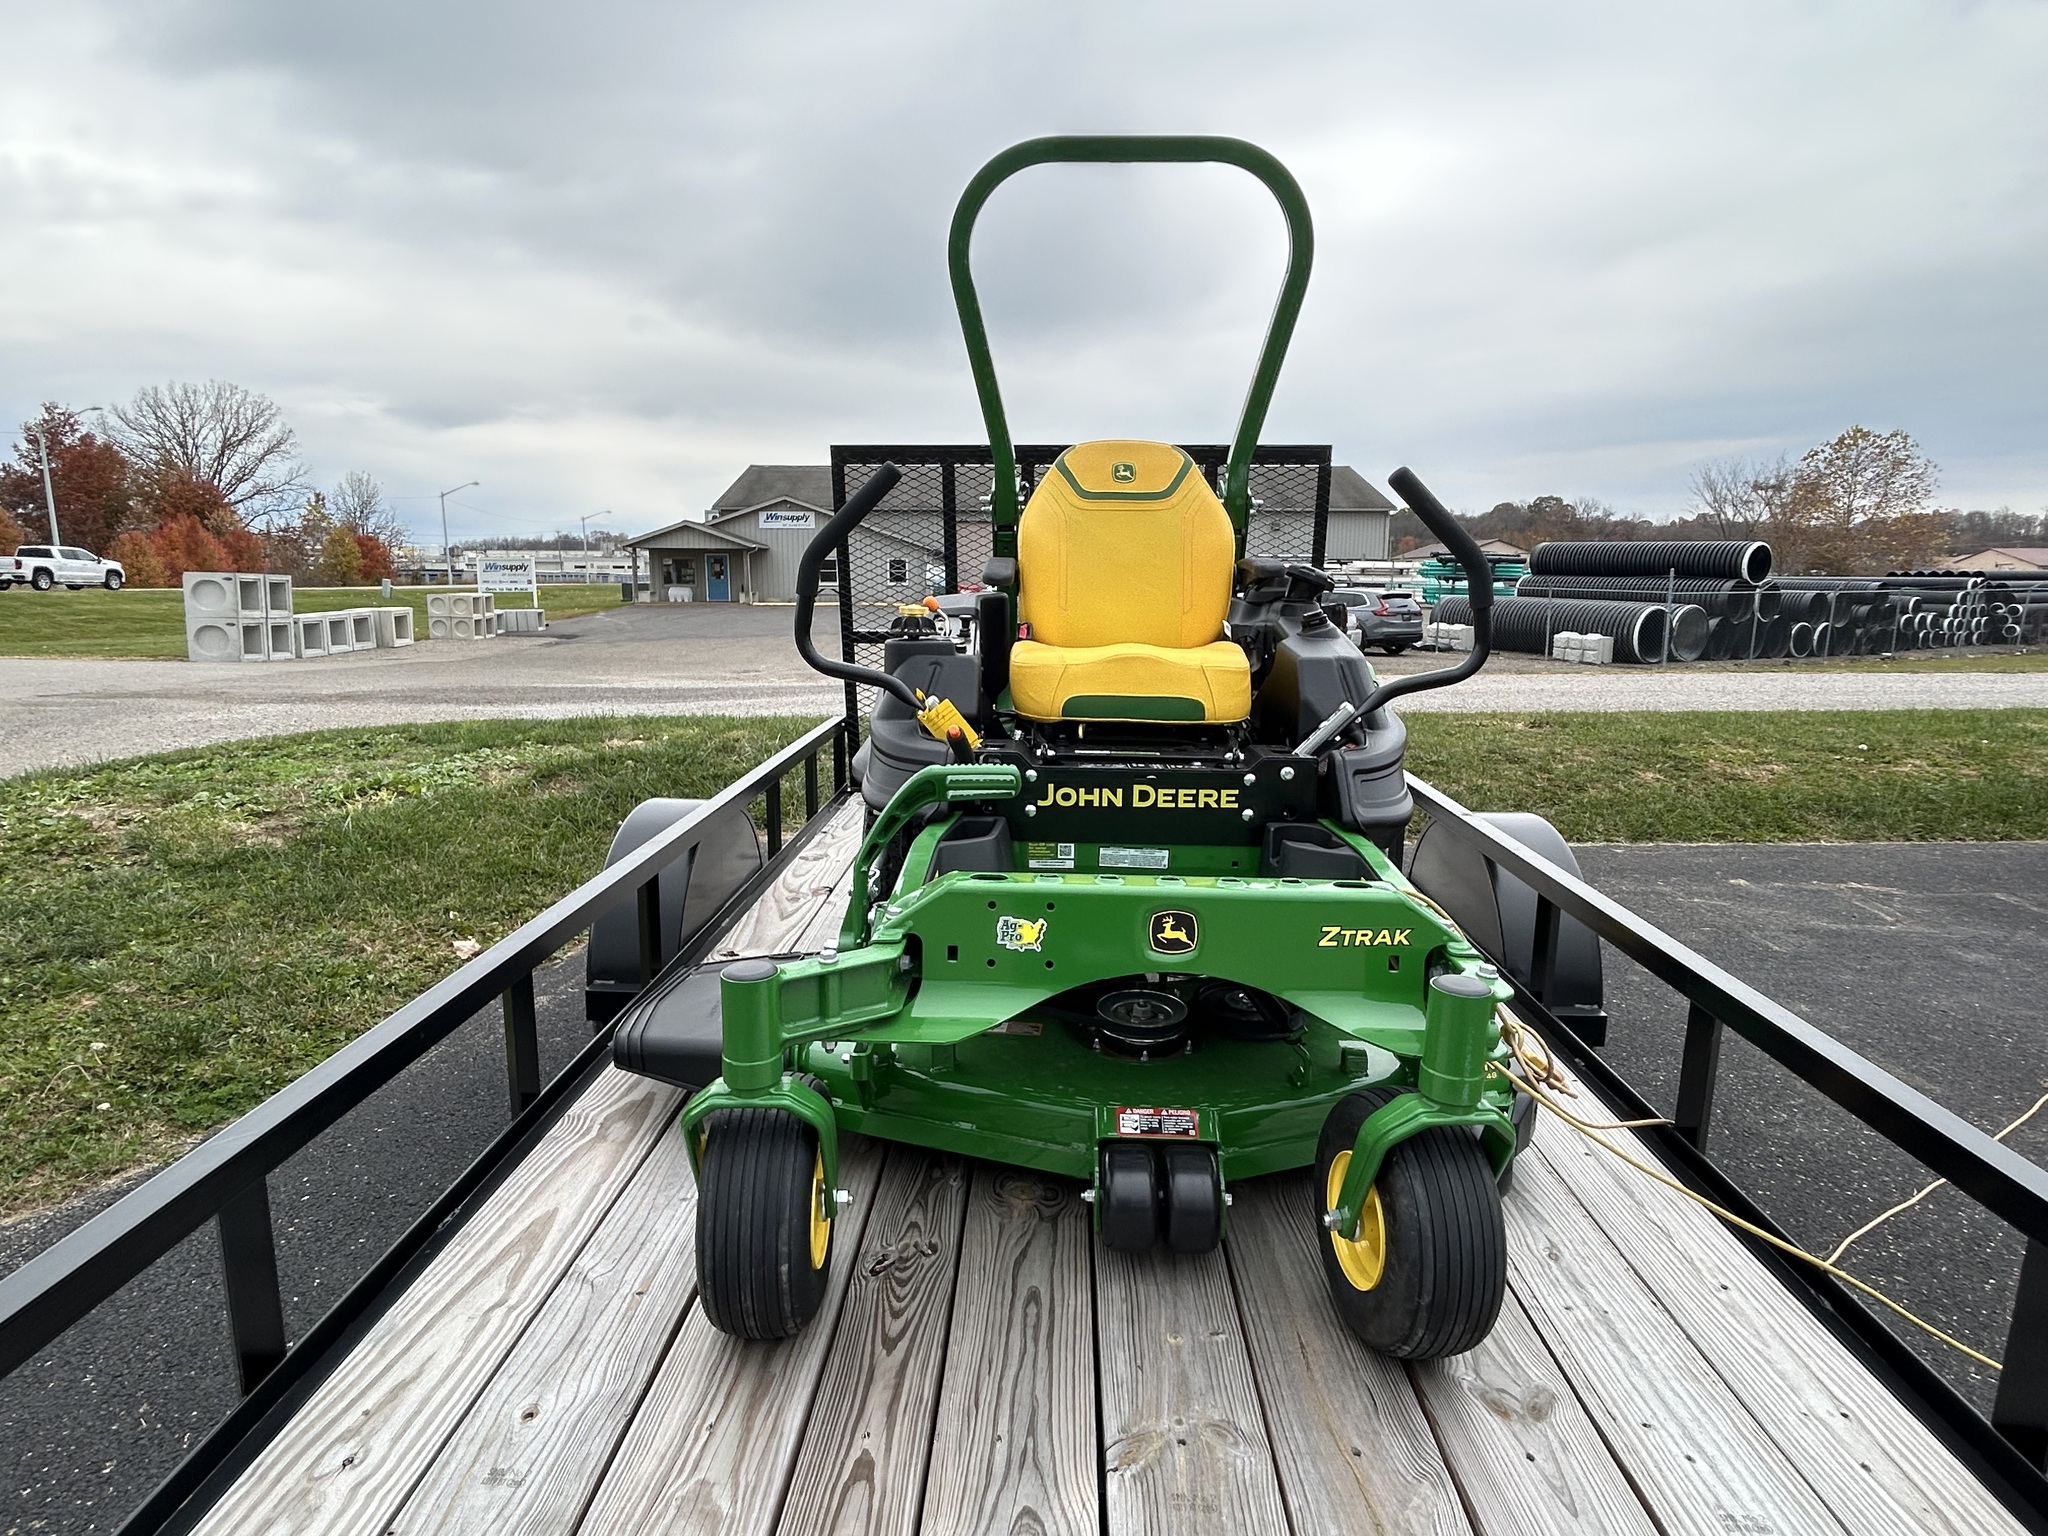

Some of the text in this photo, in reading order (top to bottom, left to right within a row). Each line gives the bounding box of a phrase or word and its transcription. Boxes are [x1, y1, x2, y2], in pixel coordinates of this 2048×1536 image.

[765, 512, 810, 523] Winsupply
[483, 562, 529, 572] Winsupply
[1037, 783, 1240, 809] JOHN DEERE
[1000, 919, 1023, 933] Ag-
[1000, 930, 1023, 941] Pro
[1317, 925, 1413, 947] ZTRAK
